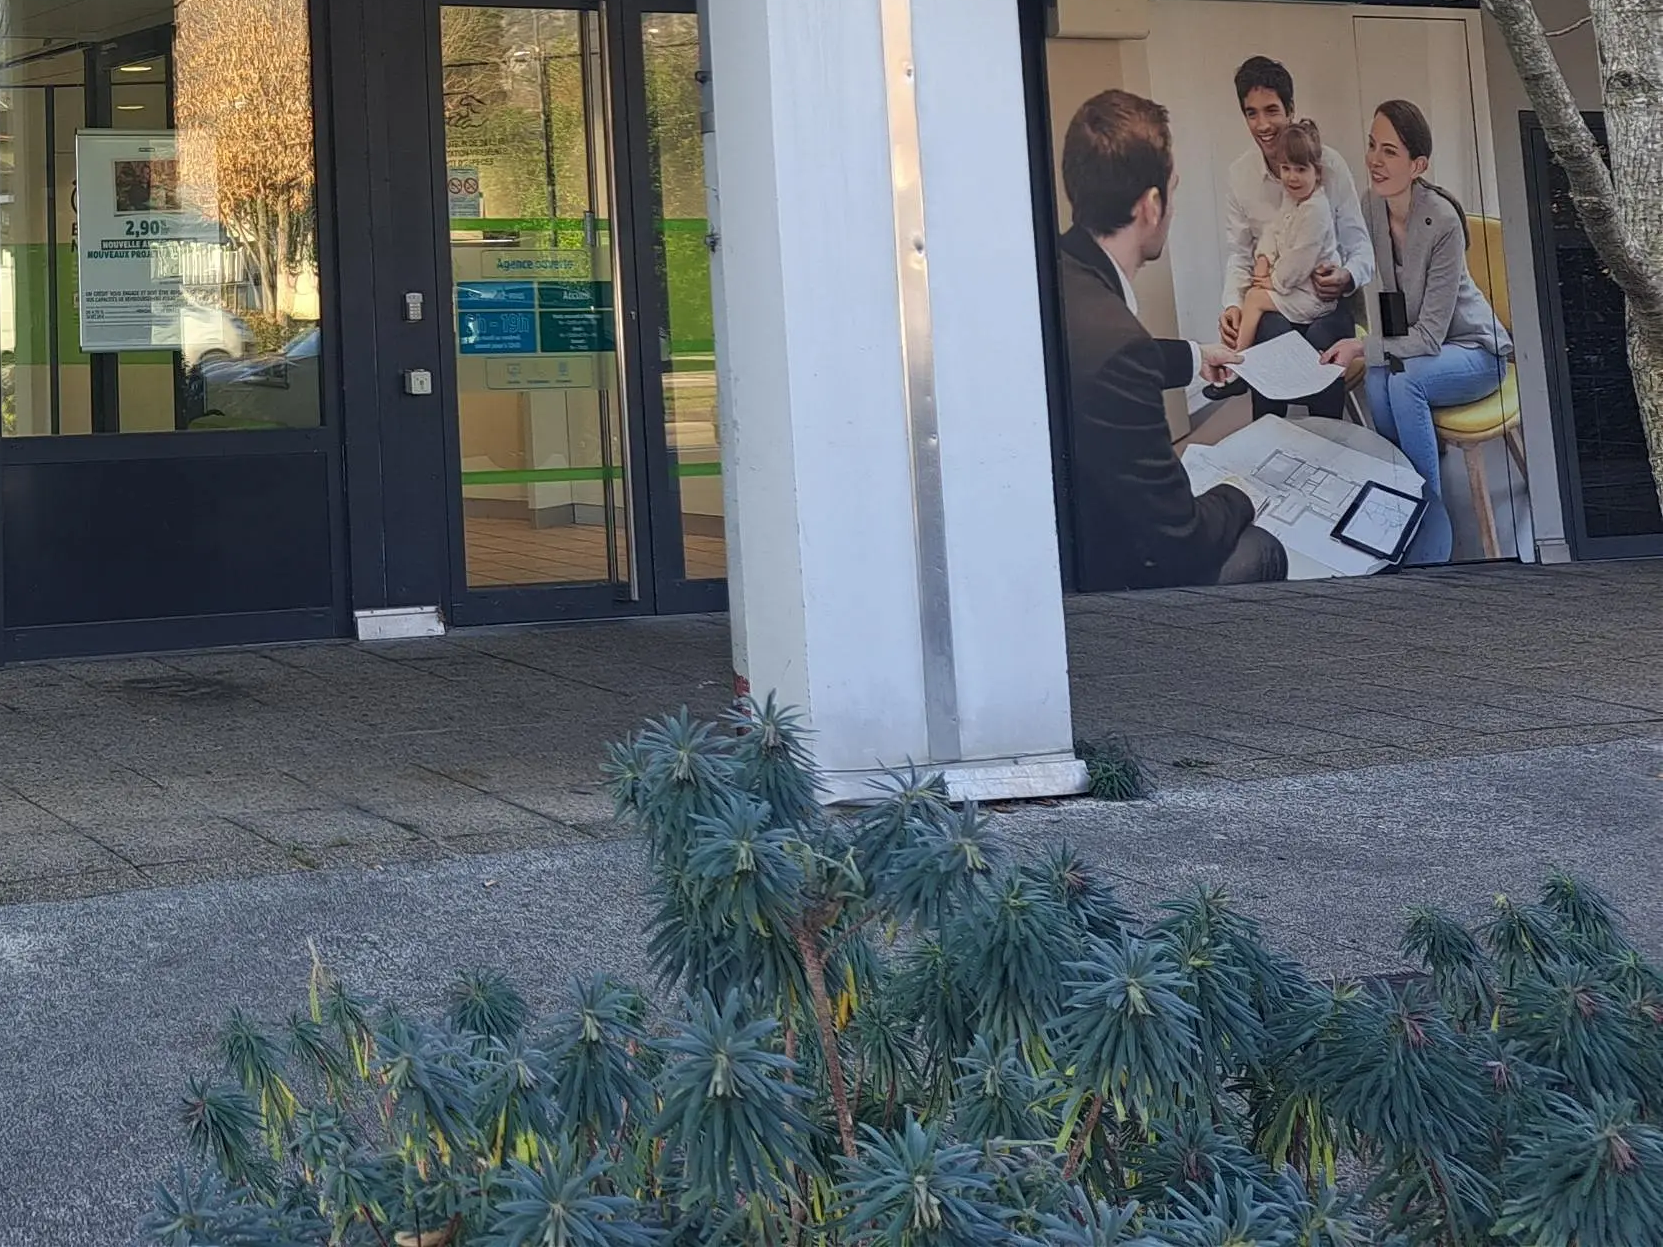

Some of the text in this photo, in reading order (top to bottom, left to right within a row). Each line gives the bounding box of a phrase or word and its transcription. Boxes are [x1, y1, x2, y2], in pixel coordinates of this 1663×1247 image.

[102, 240, 141, 249] NOUVELLE
[87, 250, 129, 259] NOUVEAUX
[496, 258, 533, 271] Agence
